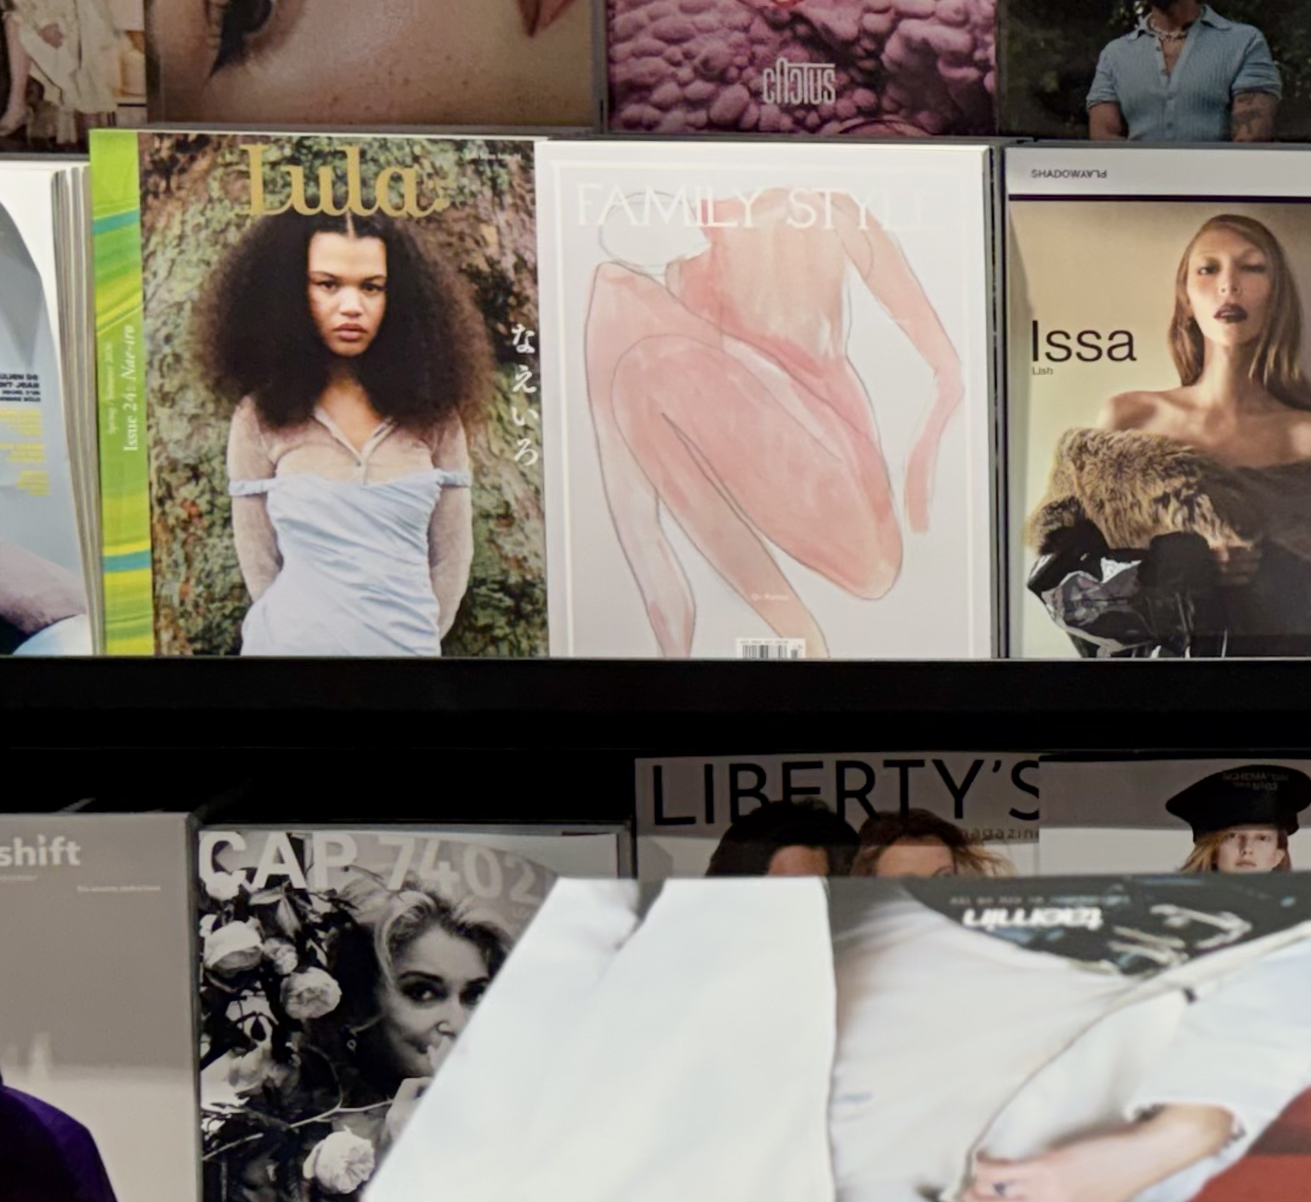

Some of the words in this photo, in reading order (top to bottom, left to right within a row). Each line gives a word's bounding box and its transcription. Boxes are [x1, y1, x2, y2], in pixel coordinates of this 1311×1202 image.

[576, 182, 769, 229] FAMILY
[785, 187, 944, 231] STYLE
[1031, 319, 1137, 364] Issa
[510, 323, 540, 468] なえいろ
[123, 415, 139, 451] Issue
[200, 831, 358, 890] CAP
